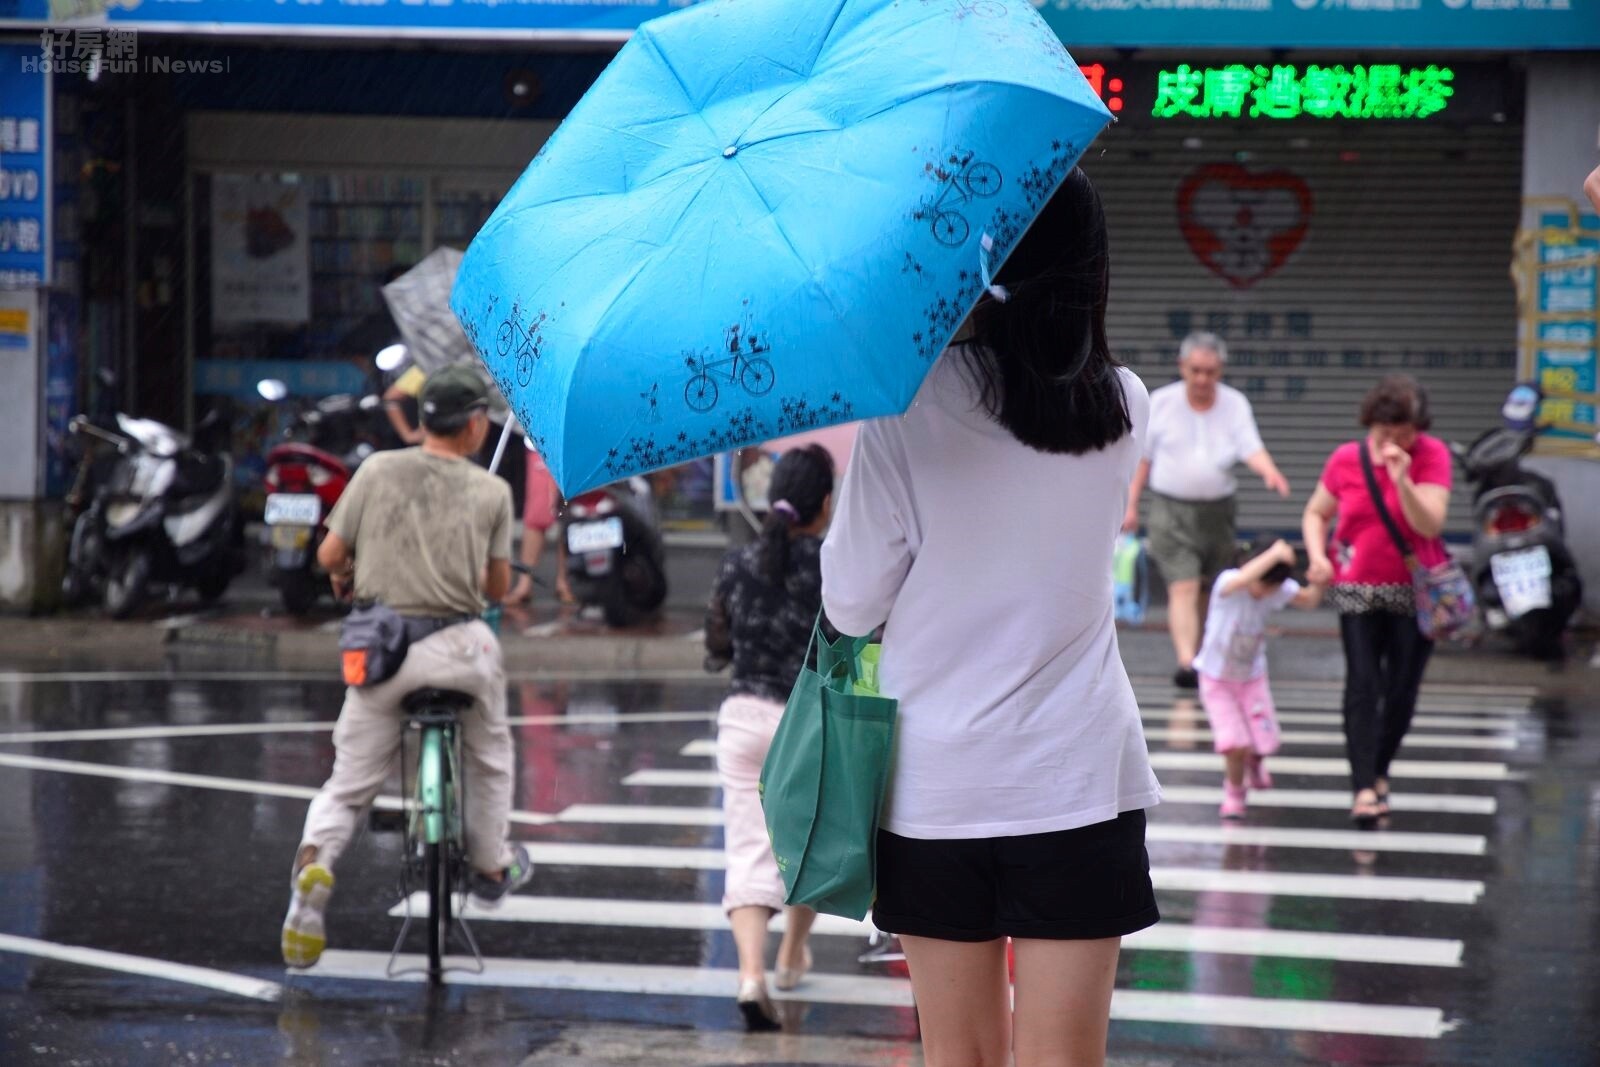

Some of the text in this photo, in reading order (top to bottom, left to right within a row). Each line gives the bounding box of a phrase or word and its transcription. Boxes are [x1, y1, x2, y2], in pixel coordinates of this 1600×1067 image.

[1151, 64, 1454, 118] 皮膚過敏濕疹
